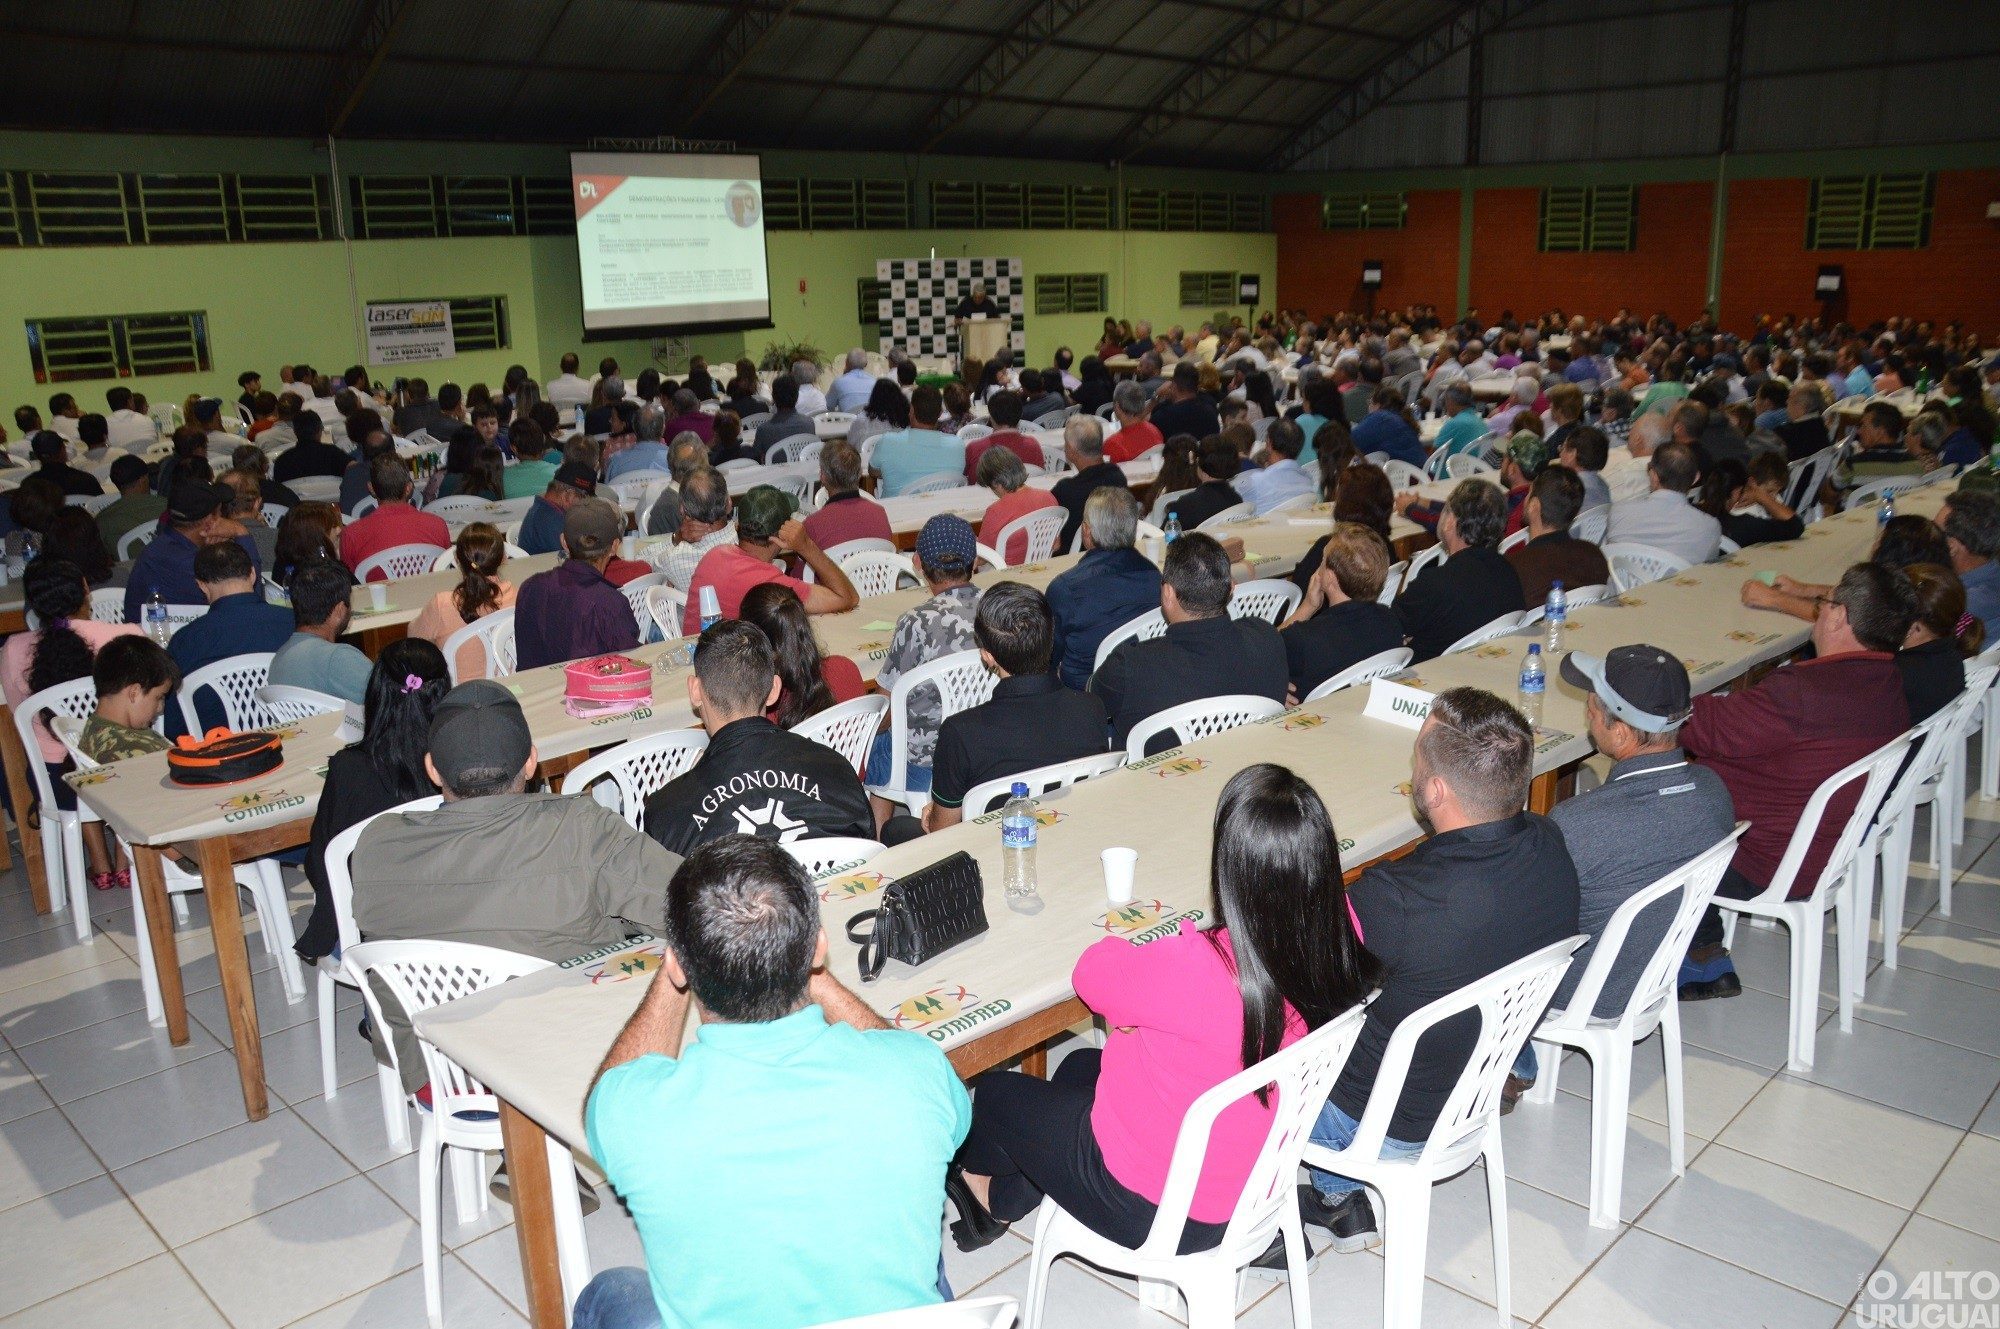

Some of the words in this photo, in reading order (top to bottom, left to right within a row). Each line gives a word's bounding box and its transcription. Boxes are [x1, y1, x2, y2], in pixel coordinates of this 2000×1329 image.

[1392, 697, 1430, 720] UNIÃ
[224, 795, 306, 823] COTRIFRED
[692, 769, 822, 832] AGRONOMIA
[559, 933, 656, 970] COTRIFRED
[926, 998, 1012, 1042] OTRIFRED
